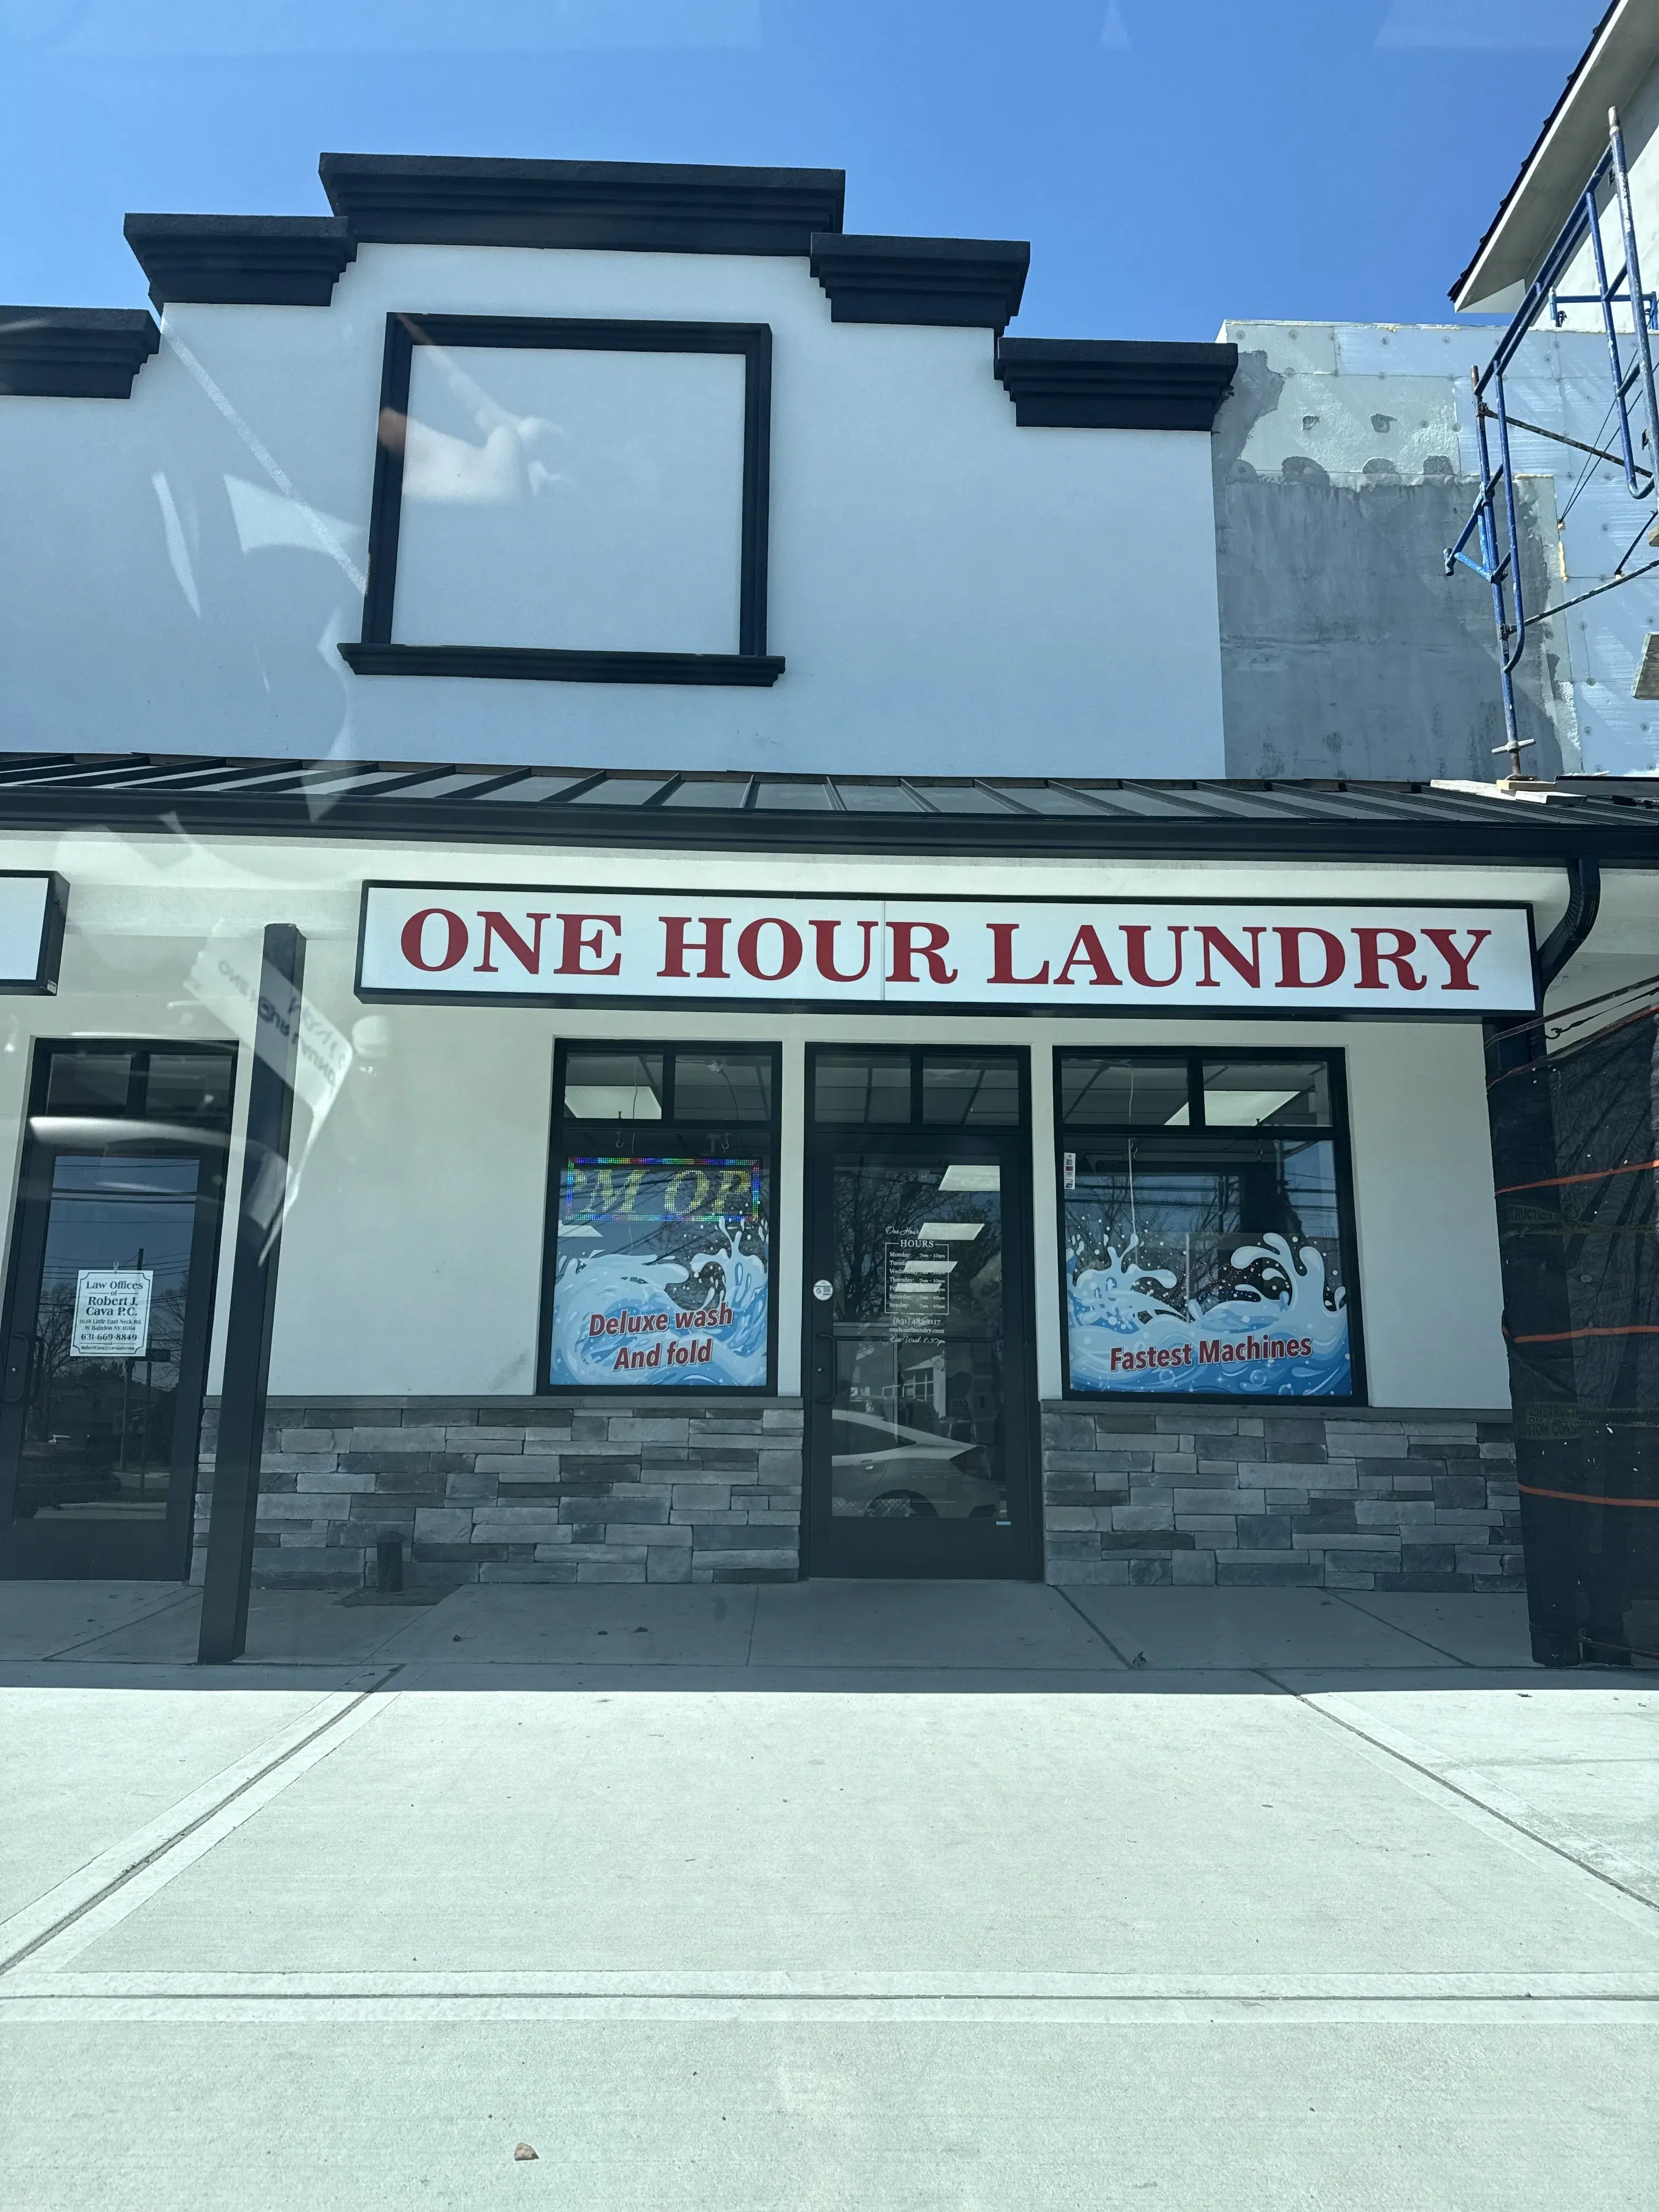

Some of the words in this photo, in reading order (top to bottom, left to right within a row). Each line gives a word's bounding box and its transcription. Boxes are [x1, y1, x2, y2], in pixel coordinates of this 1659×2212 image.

[400, 908, 622, 975] ONE
[656, 916, 958, 986] HOUR
[986, 923, 1492, 991] LAUNDRY
[885, 1226, 900, 1234] One
[86, 1281, 108, 1289] Law
[110, 1281, 143, 1290] Offices
[88, 1296, 127, 1306] Robert
[130, 1297, 138, 1306] J.
[86, 1307, 113, 1316] Cava
[117, 1307, 137, 1316] P.C.
[589, 1310, 669, 1338] Deluxe
[674, 1301, 733, 1330] wash
[893, 1317, 910, 1325] (631)
[613, 1342, 661, 1372] And
[667, 1338, 713, 1366] fold
[1110, 1342, 1193, 1372] Fastest
[1198, 1334, 1312, 1365] Machines
